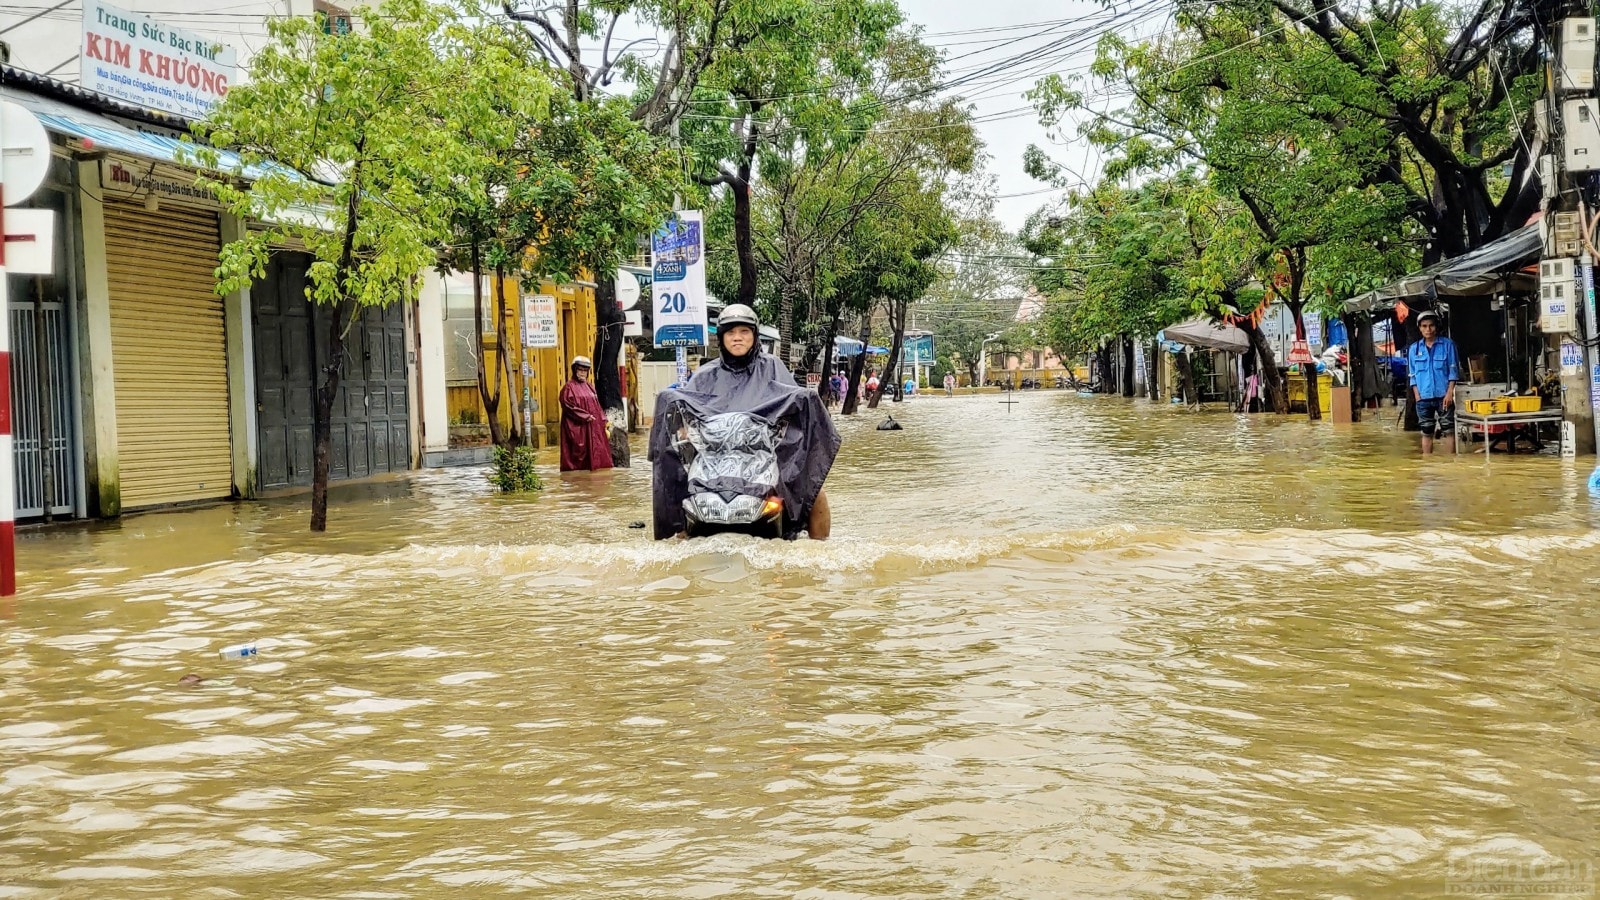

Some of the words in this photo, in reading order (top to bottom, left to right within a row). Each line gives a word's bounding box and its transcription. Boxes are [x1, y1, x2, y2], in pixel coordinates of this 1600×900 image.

[97, 7, 136, 38] Trang
[142, 24, 165, 43] Sức
[170, 32, 191, 56] Bạc
[195, 40, 216, 60] Rin
[86, 32, 131, 69] KIM
[139, 48, 228, 96] KHƯƠNG
[97, 67, 108, 78] Mua
[656, 264, 663, 274] 4
[663, 265, 682, 273] XANH
[660, 292, 686, 313] 20
